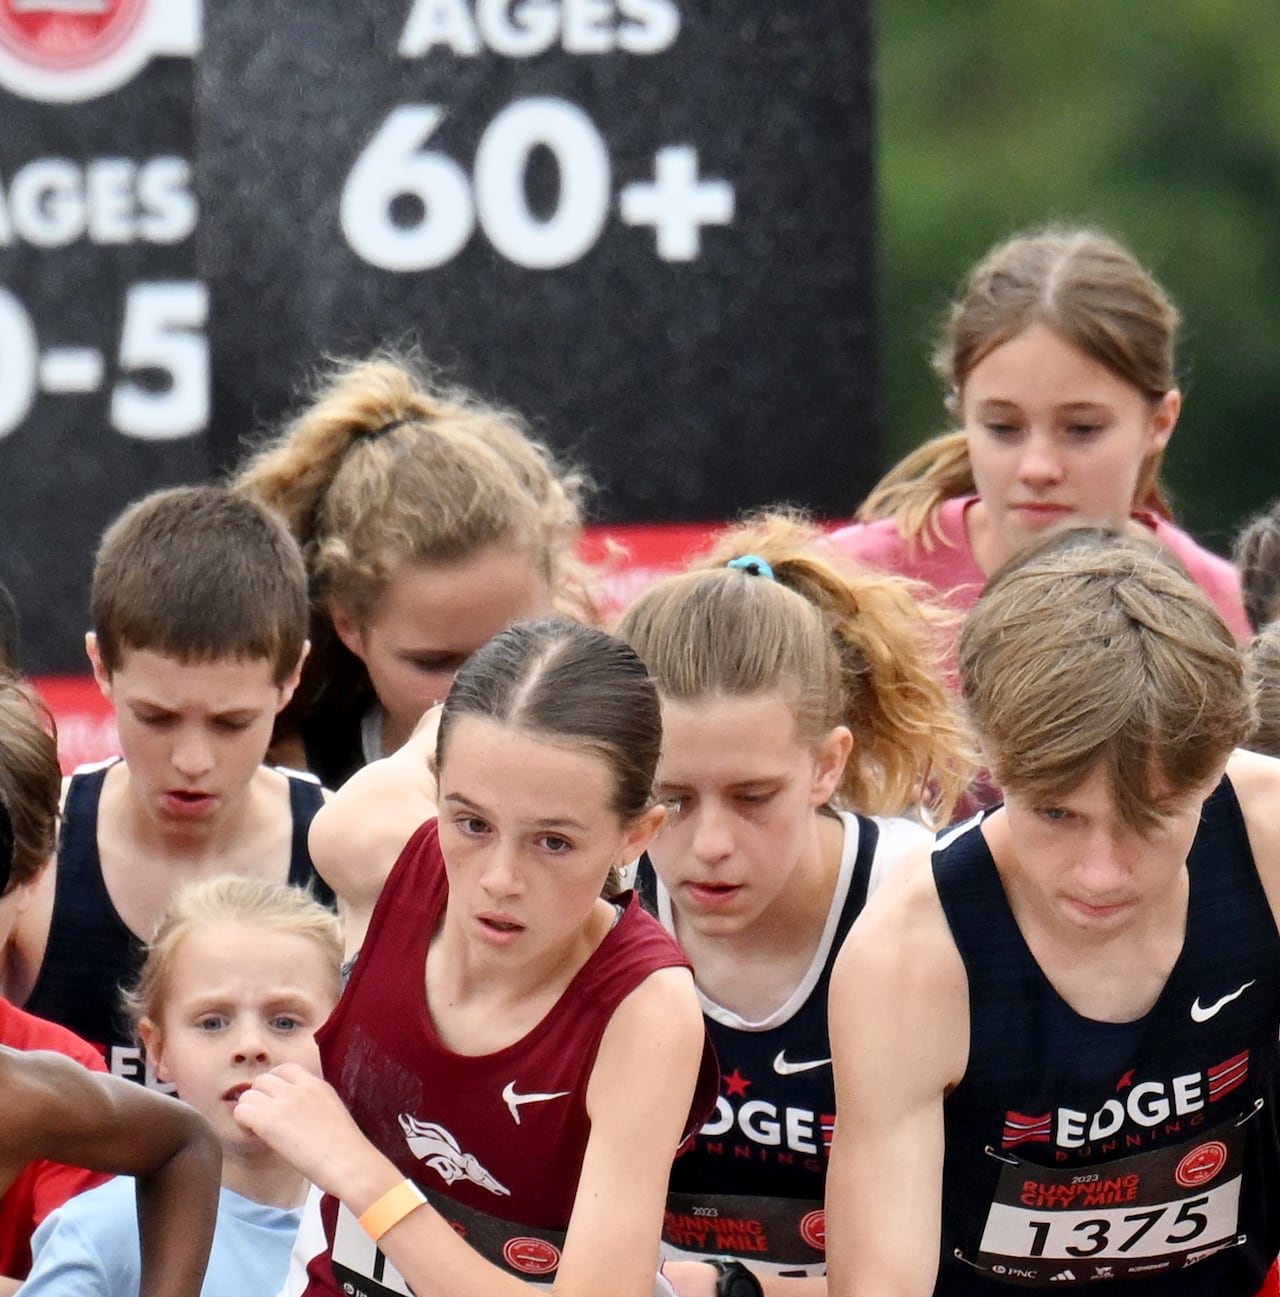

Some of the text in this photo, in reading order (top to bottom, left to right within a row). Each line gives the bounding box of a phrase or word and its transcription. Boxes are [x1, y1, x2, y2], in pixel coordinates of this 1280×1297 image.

[398, 0, 683, 58] AGES
[340, 96, 735, 272] 60+
[1055, 1071, 1205, 1148] EDGE
[1022, 1172, 1140, 1197] RUNNING
[1072, 1173, 1100, 1184] 2023
[1020, 1186, 1138, 1208] CITY MILE
[692, 1206, 719, 1217] 2023
[1028, 1196, 1210, 1257] 1375
[716, 1232, 769, 1252] MILE
[1008, 1268, 1039, 1280] PNC
